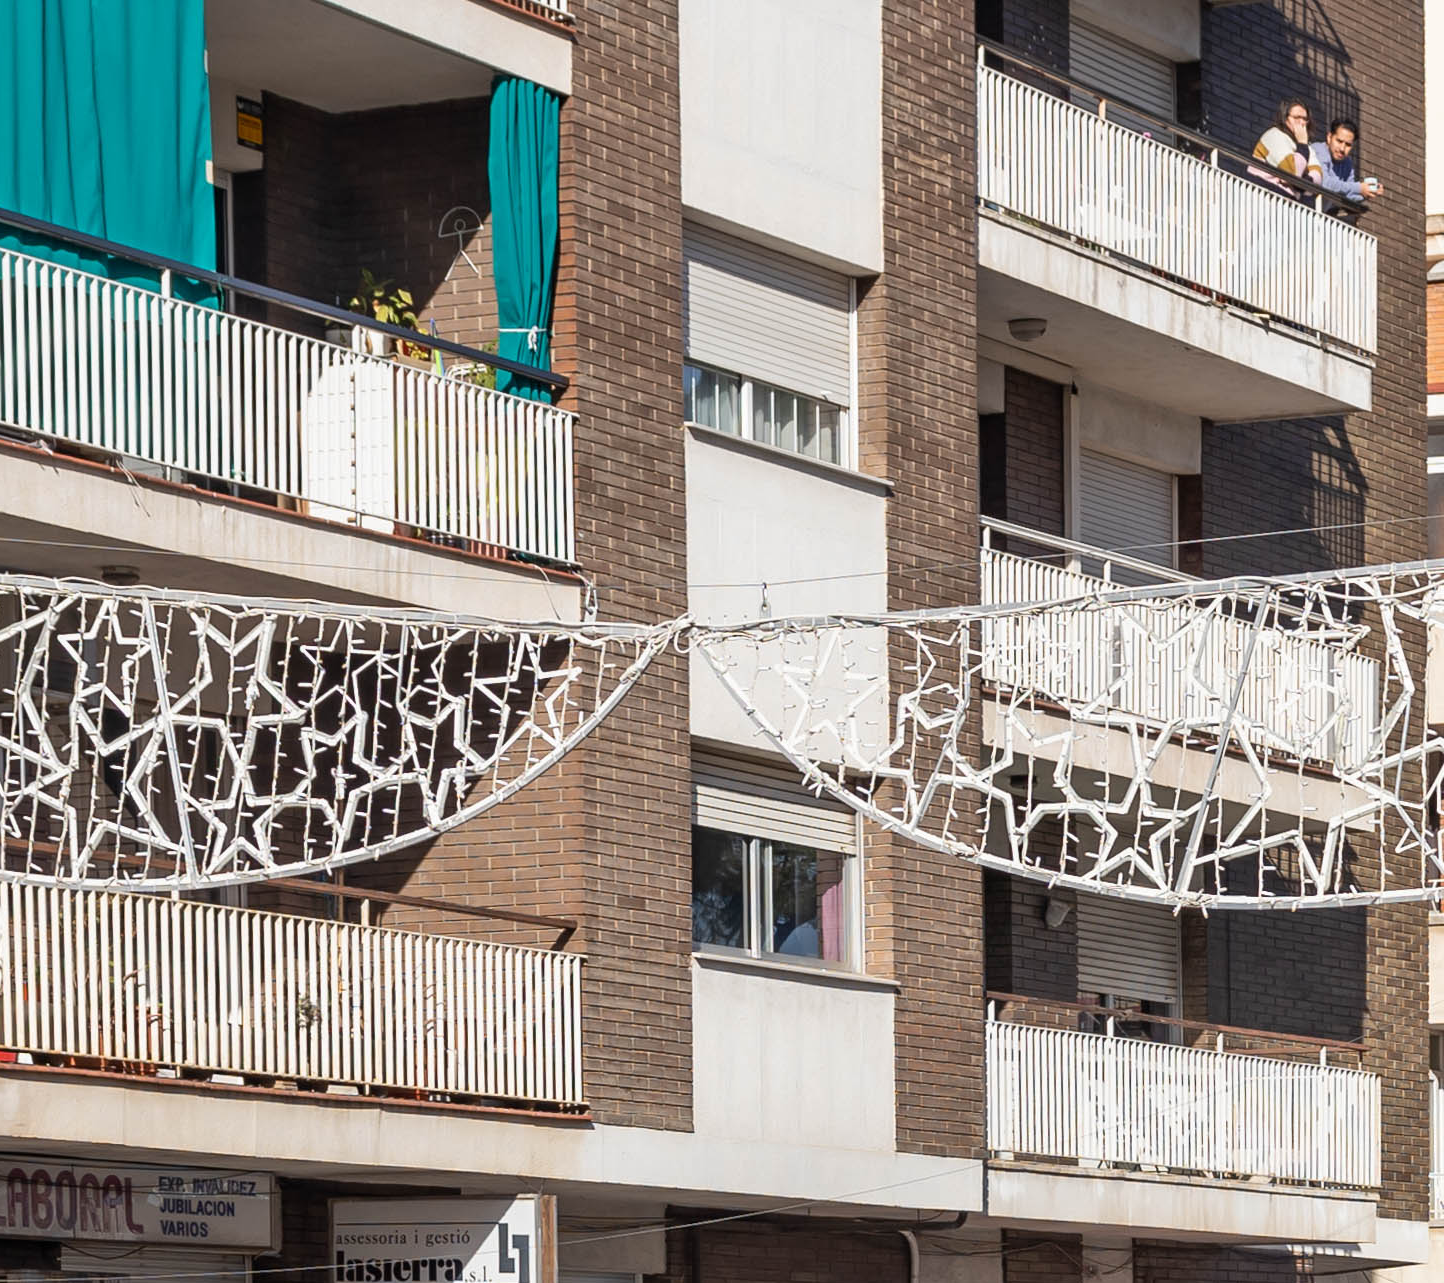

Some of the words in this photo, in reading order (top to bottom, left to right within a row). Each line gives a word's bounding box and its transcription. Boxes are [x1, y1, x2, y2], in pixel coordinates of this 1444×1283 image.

[159, 1199, 235, 1217] JUBILACION
[160, 1219, 209, 1238] VARIOS
[336, 1230, 407, 1245] assessoria
[414, 1230, 419, 1244] i
[425, 1229, 470, 1247] gestió
